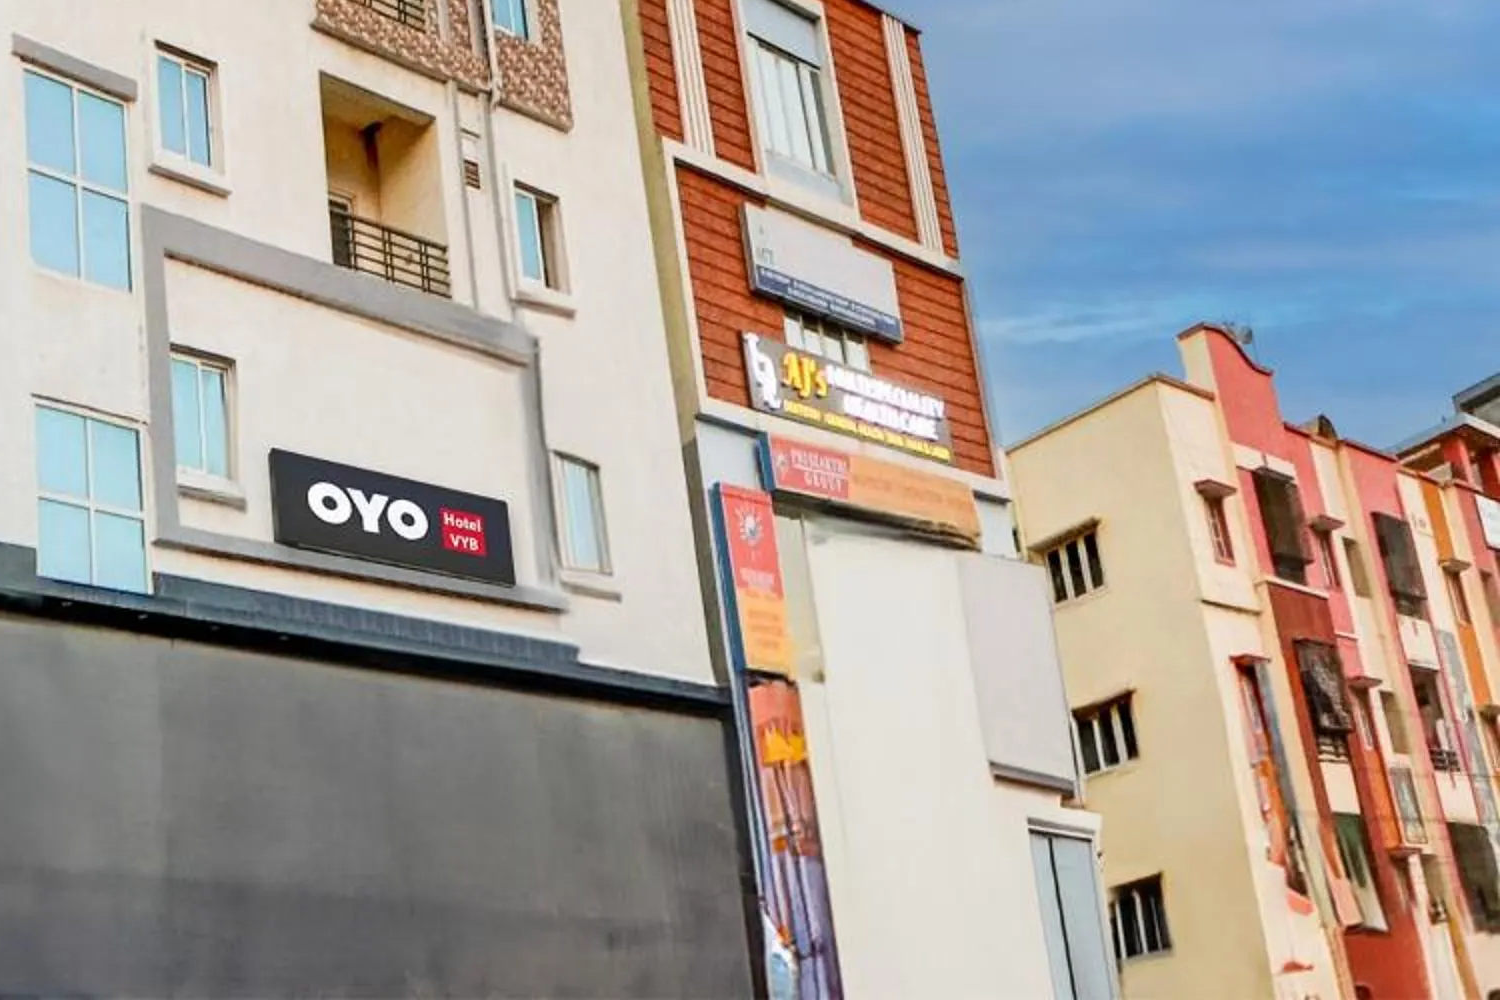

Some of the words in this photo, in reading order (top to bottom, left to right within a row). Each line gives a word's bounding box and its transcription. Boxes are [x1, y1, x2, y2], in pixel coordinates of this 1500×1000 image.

[308, 482, 429, 540] OYO
[443, 512, 482, 534] Hotel
[450, 533, 479, 551] VYB
